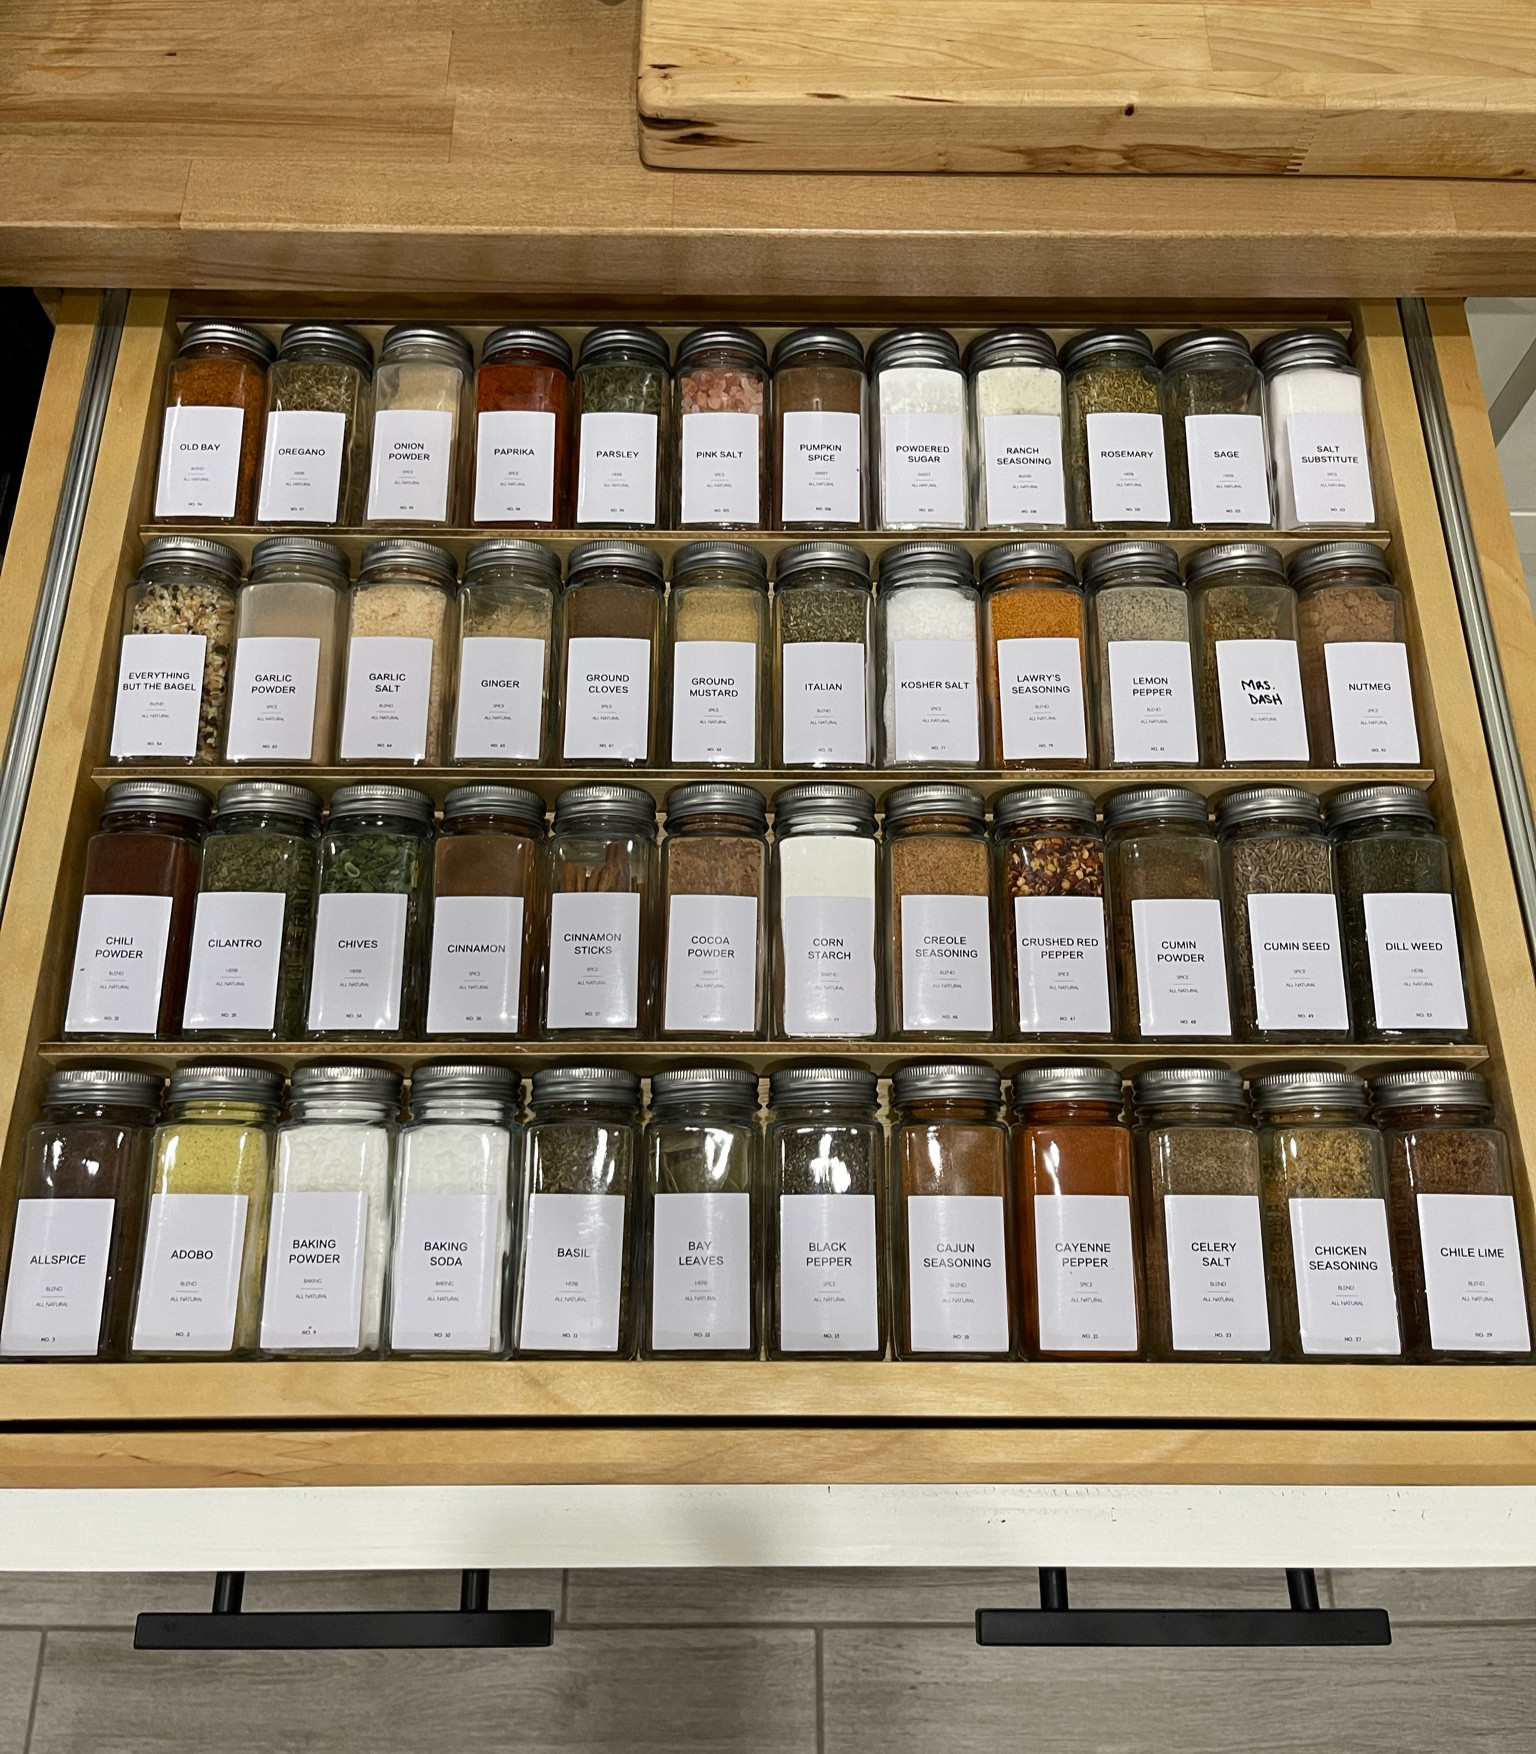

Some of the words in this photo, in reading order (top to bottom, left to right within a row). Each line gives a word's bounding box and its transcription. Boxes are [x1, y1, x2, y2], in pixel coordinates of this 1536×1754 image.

[179, 443, 199, 451] OLD
[200, 443, 221, 451] BAY
[393, 442, 425, 450] ONION
[799, 443, 842, 452] PUMPKIN
[895, 445, 950, 454] POWDERED
[1006, 446, 1040, 455] RANCH
[1316, 445, 1340, 453] SALT
[278, 447, 326, 457] OREGANO
[388, 452, 430, 461] POWDER
[493, 448, 535, 456] PAPRIKA
[596, 450, 640, 459] PARSLEY
[696, 450, 718, 459] PINK
[719, 450, 743, 459] SALT
[1100, 450, 1154, 459] ROSEMARY
[1213, 450, 1240, 459] SAGE
[807, 454, 836, 462] SPICE
[907, 455, 941, 464] SUGAR
[996, 457, 1052, 466] SEASONING
[1301, 455, 1359, 464] SUBSTITUTE
[128, 671, 190, 680] EVERYTHING
[254, 674, 292, 683] GARLIC
[368, 672, 406, 682] GARLIC
[586, 673, 630, 683] GROUND
[1016, 673, 1062, 683] LAWRY'S
[1132, 676, 1169, 685] LEMON
[480, 679, 520, 689] GINGER
[691, 677, 735, 686] GROUND
[901, 681, 943, 689] KOSHER
[944, 681, 970, 690] SALT
[1240, 679, 1276, 691] MRS.
[1348, 682, 1392, 691] NUTMEG
[122, 682, 141, 691] BUT
[144, 682, 162, 691] THE
[163, 682, 197, 692] BAGEL
[251, 685, 296, 694] POWDER
[374, 684, 401, 693] SALT
[588, 685, 629, 694] CLOVES
[804, 683, 843, 691] ITALIAN
[1011, 685, 1071, 695] SEASONING
[689, 688, 739, 698] MUSTARD
[1132, 688, 1173, 697] PEPPER
[1247, 692, 1283, 706] DASH
[105, 936, 134, 946] CHILI
[563, 933, 622, 942] CINNAMON
[691, 935, 730, 945] COCOA
[812, 938, 844, 947] CORN
[923, 936, 967, 945] CREOLE
[1021, 937, 1075, 947] CRUSHED
[1076, 937, 1099, 947] RED
[207, 938, 263, 948] CILANTRO
[337, 939, 378, 949] CHIVES
[1161, 940, 1197, 950] CUMIN
[1263, 942, 1300, 951] CUMIN
[1302, 942, 1331, 951] SEED
[1385, 942, 1409, 951] DILL
[1410, 942, 1443, 951] WEED
[94, 949, 144, 959] POWDER
[447, 944, 506, 954] CINNAMON
[574, 945, 613, 955] STICKS
[687, 948, 735, 959] POWDER
[915, 948, 978, 959] SEASONING
[807, 950, 851, 960] STARCH
[1040, 950, 1084, 960] PEPPER
[1157, 953, 1206, 963] POWDER
[292, 1239, 337, 1249] BAKING
[424, 1241, 468, 1252] BAKING
[688, 1241, 712, 1251] BAY
[808, 1242, 847, 1252] BLACK
[936, 1243, 975, 1253] CAJUN
[1055, 1242, 1111, 1253] CAYENNE
[1191, 1242, 1237, 1253] CELERY
[170, 1249, 214, 1260] ADOBO
[557, 1247, 590, 1258] BASIL
[1314, 1245, 1367, 1256] CHICKEN
[1440, 1247, 1475, 1258] CHILE
[1477, 1248, 1505, 1259] LIME
[29, 1254, 87, 1265] ALLSPICE
[288, 1253, 341, 1264] POWDER
[429, 1256, 463, 1267] SODA
[678, 1255, 724, 1266] LEAVES
[806, 1256, 853, 1267] PEPPER
[923, 1257, 992, 1268] SEASONING
[1062, 1257, 1109, 1268] PEPPER
[1202, 1256, 1231, 1267] SALT
[1309, 1260, 1378, 1271] SEASONING
